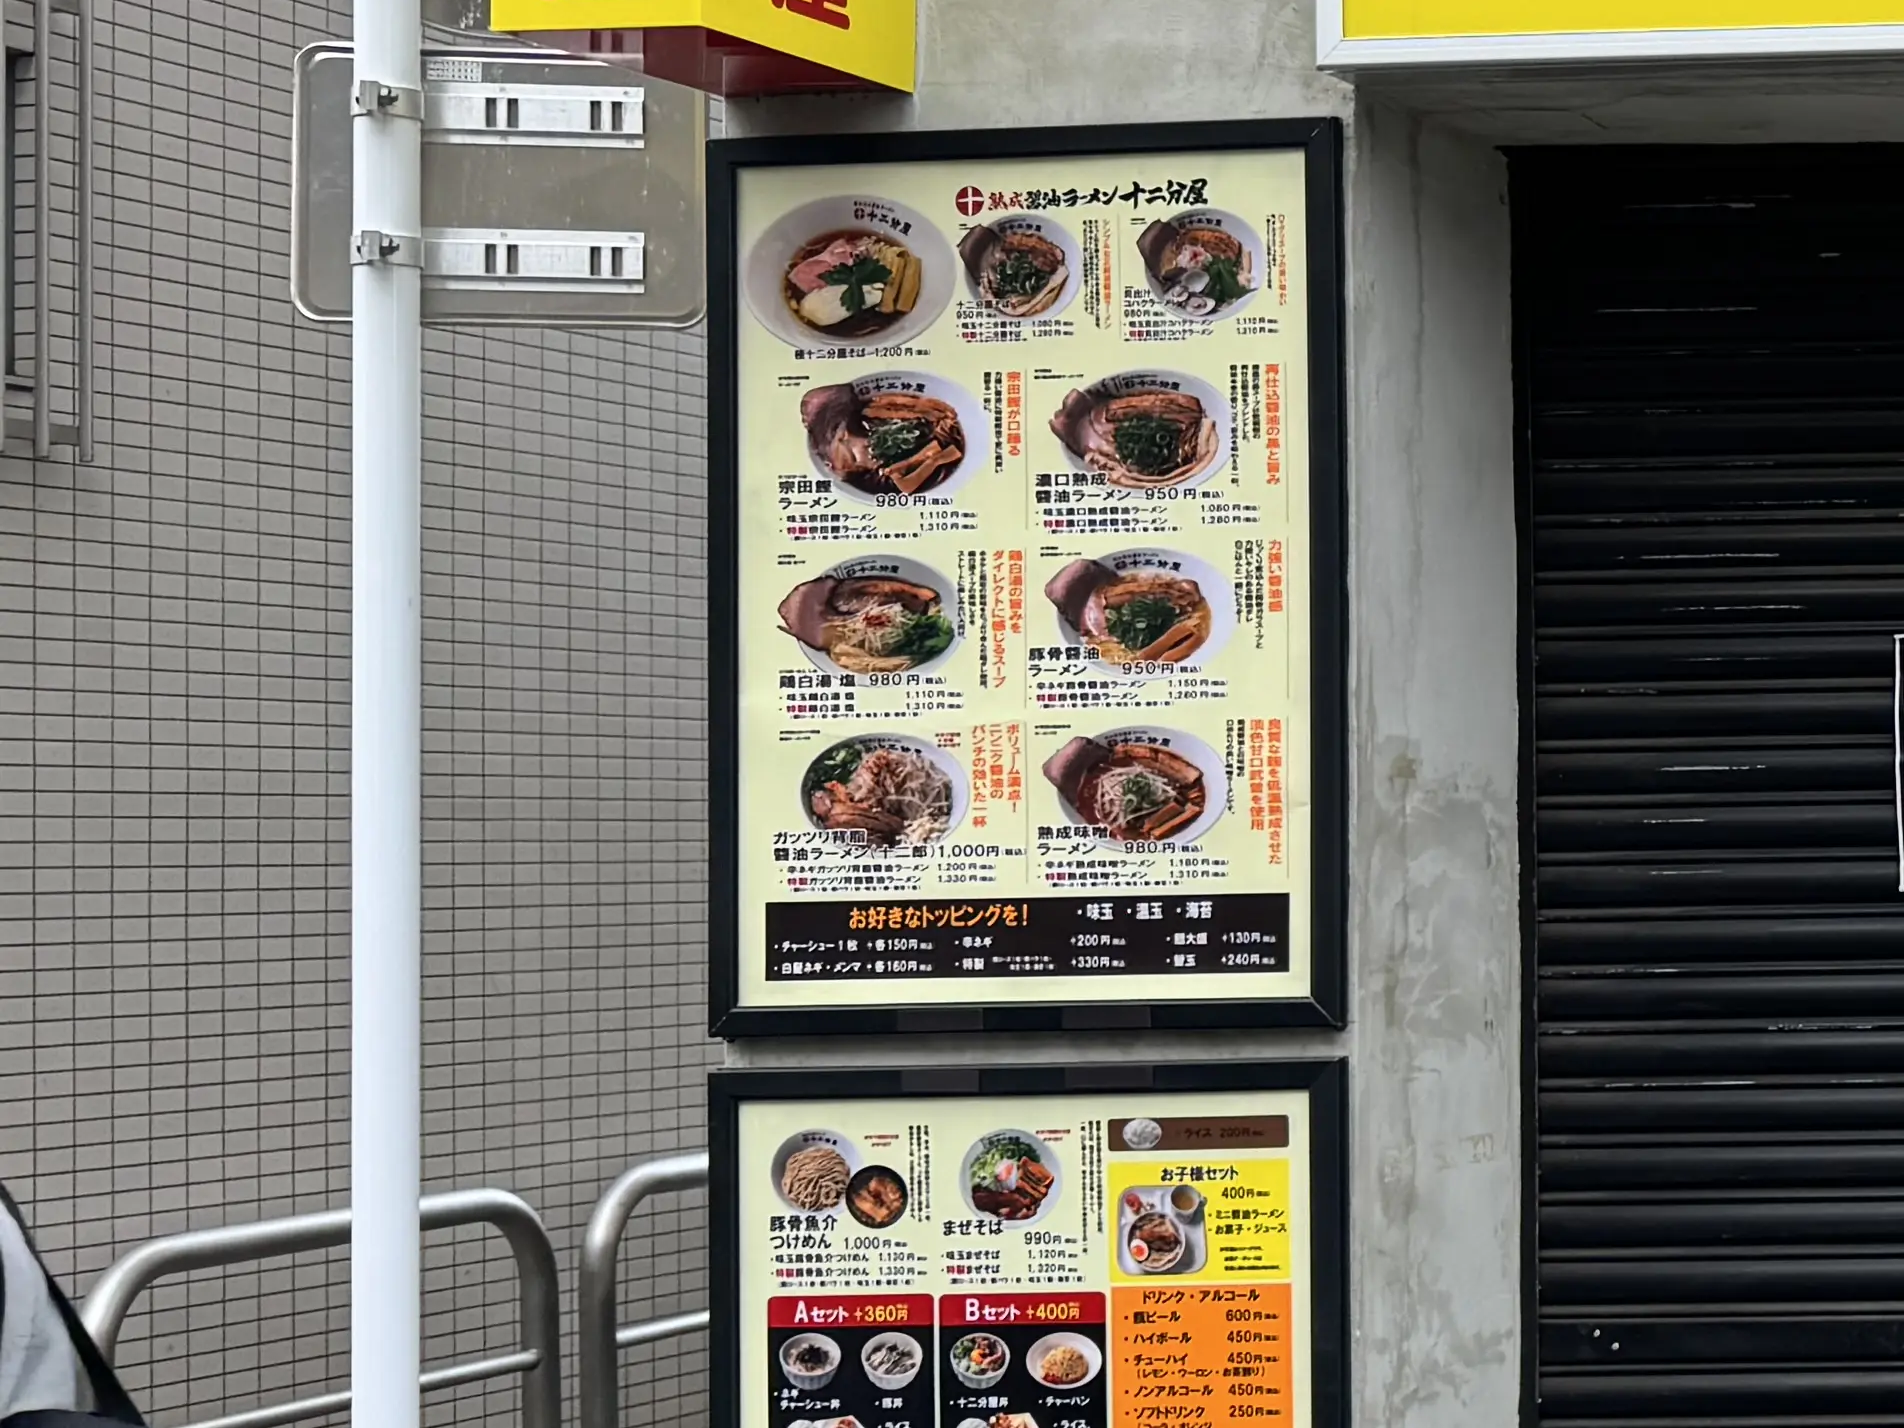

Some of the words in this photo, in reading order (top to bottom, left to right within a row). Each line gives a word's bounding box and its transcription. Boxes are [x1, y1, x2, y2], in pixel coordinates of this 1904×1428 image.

[778, 497, 838, 510] ラーメン
[1035, 489, 1131, 504] 醤油ラーメン
[1028, 664, 1088, 677] ラーメン
[1037, 843, 1097, 855] ラーメン
[849, 904, 1029, 929] お好きなトッピングを!
[1161, 1165, 1239, 1182] お子様セット
[943, 1220, 1003, 1236] まぜそば
[770, 1234, 832, 1249] つけめん
[794, 1300, 849, 1323] Aセット
[965, 1298, 1020, 1321] Bセット
[1133, 1332, 1192, 1344] ハイボール
[1133, 1353, 1188, 1366] チューハイ
[1133, 1385, 1214, 1397] ノンアルコール
[1133, 1406, 1205, 1419] ソフトドリンク
